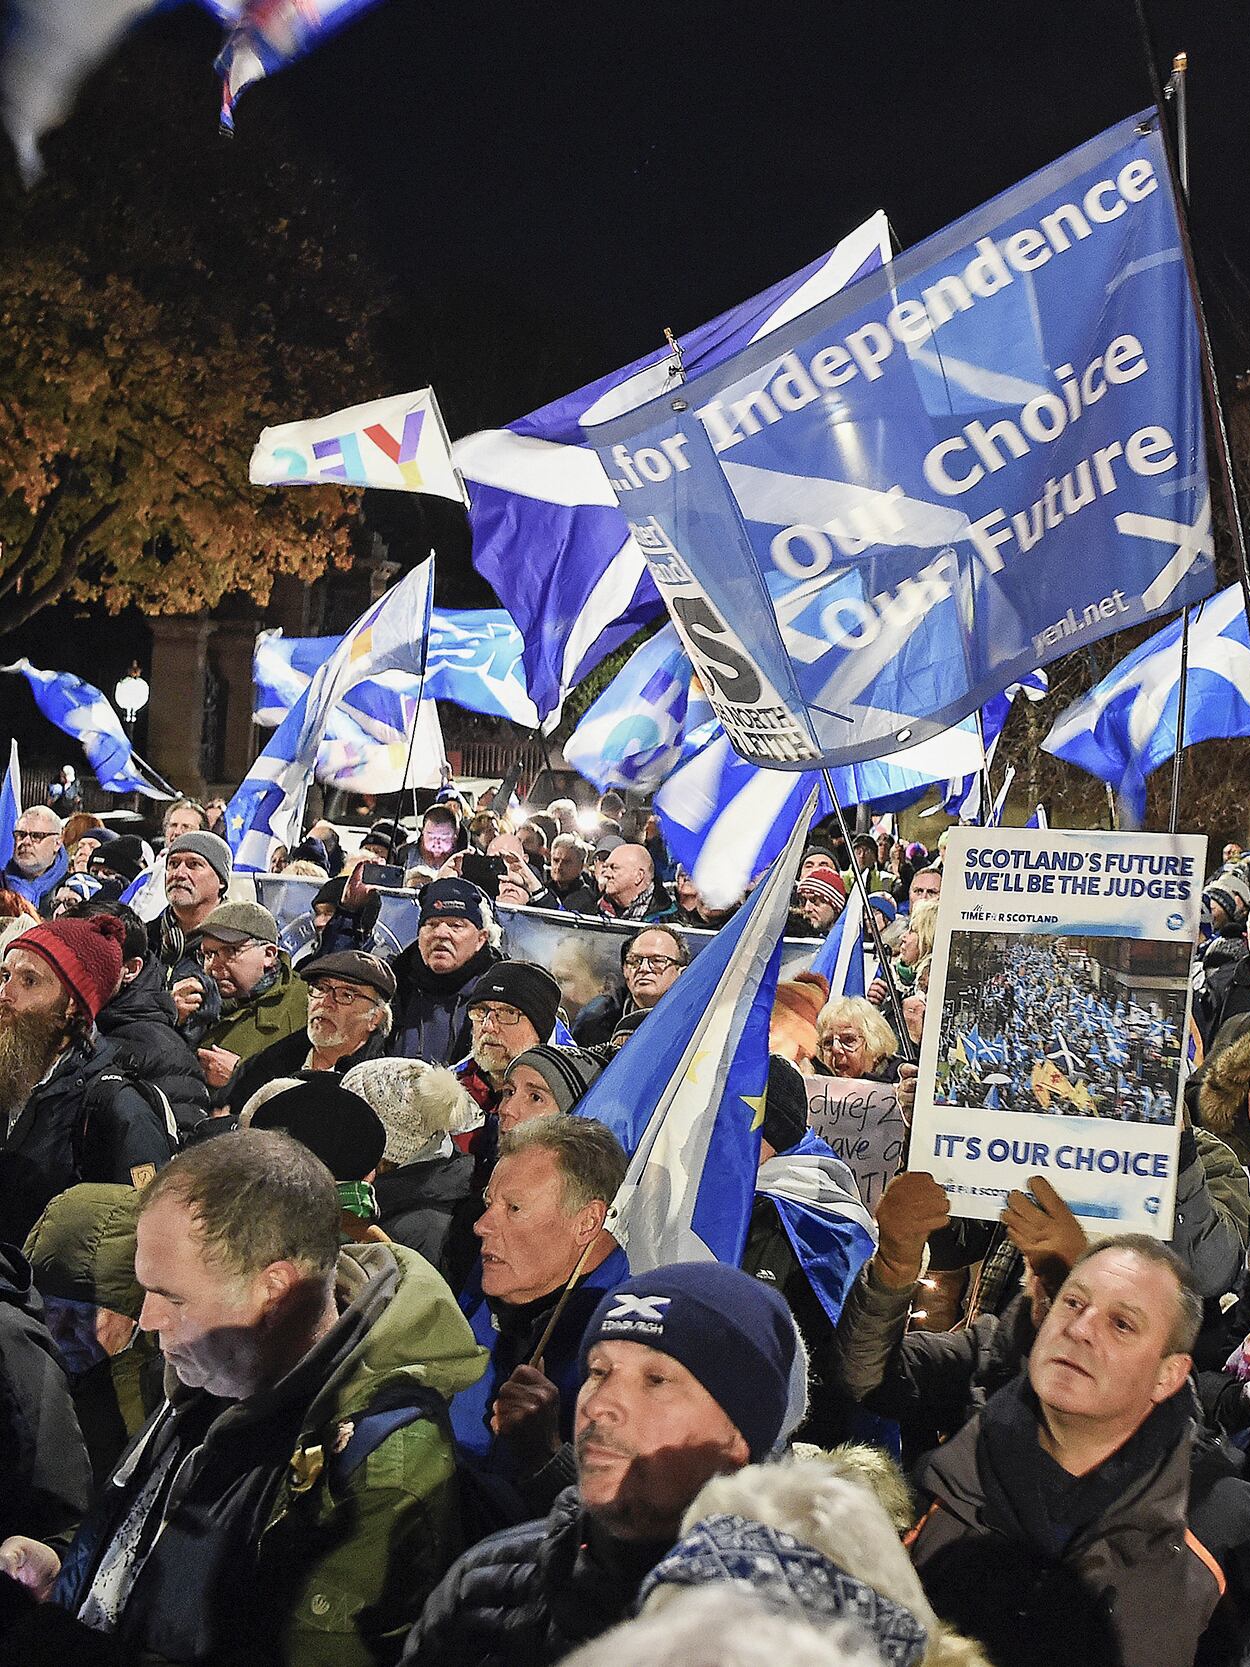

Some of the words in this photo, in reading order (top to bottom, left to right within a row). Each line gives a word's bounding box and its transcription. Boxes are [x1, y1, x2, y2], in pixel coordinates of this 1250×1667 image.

[699, 158, 1160, 449] Independence
[769, 484, 906, 580] Our
[923, 333, 1149, 497] Choice
[820, 552, 954, 650] Our
[966, 424, 1178, 573] Future
[672, 596, 763, 703] S
[725, 705, 796, 730] NORTH
[965, 848, 1102, 873] SCOTLAND'S
[1105, 853, 1195, 877] FUTURE
[964, 871, 1027, 892] WE'LL
[1027, 875, 1056, 894] BE
[1058, 876, 1100, 896] THE
[1103, 878, 1191, 901] JUDGES
[960, 911, 984, 921] TIME
[1006, 913, 1059, 924] SCOTLAND
[808, 1083, 878, 1132] dyref
[876, 1096, 903, 1126] 2
[933, 1134, 981, 1160] IT'S
[987, 1138, 1050, 1167] OUR
[1055, 1145, 1169, 1178] CHOICE
